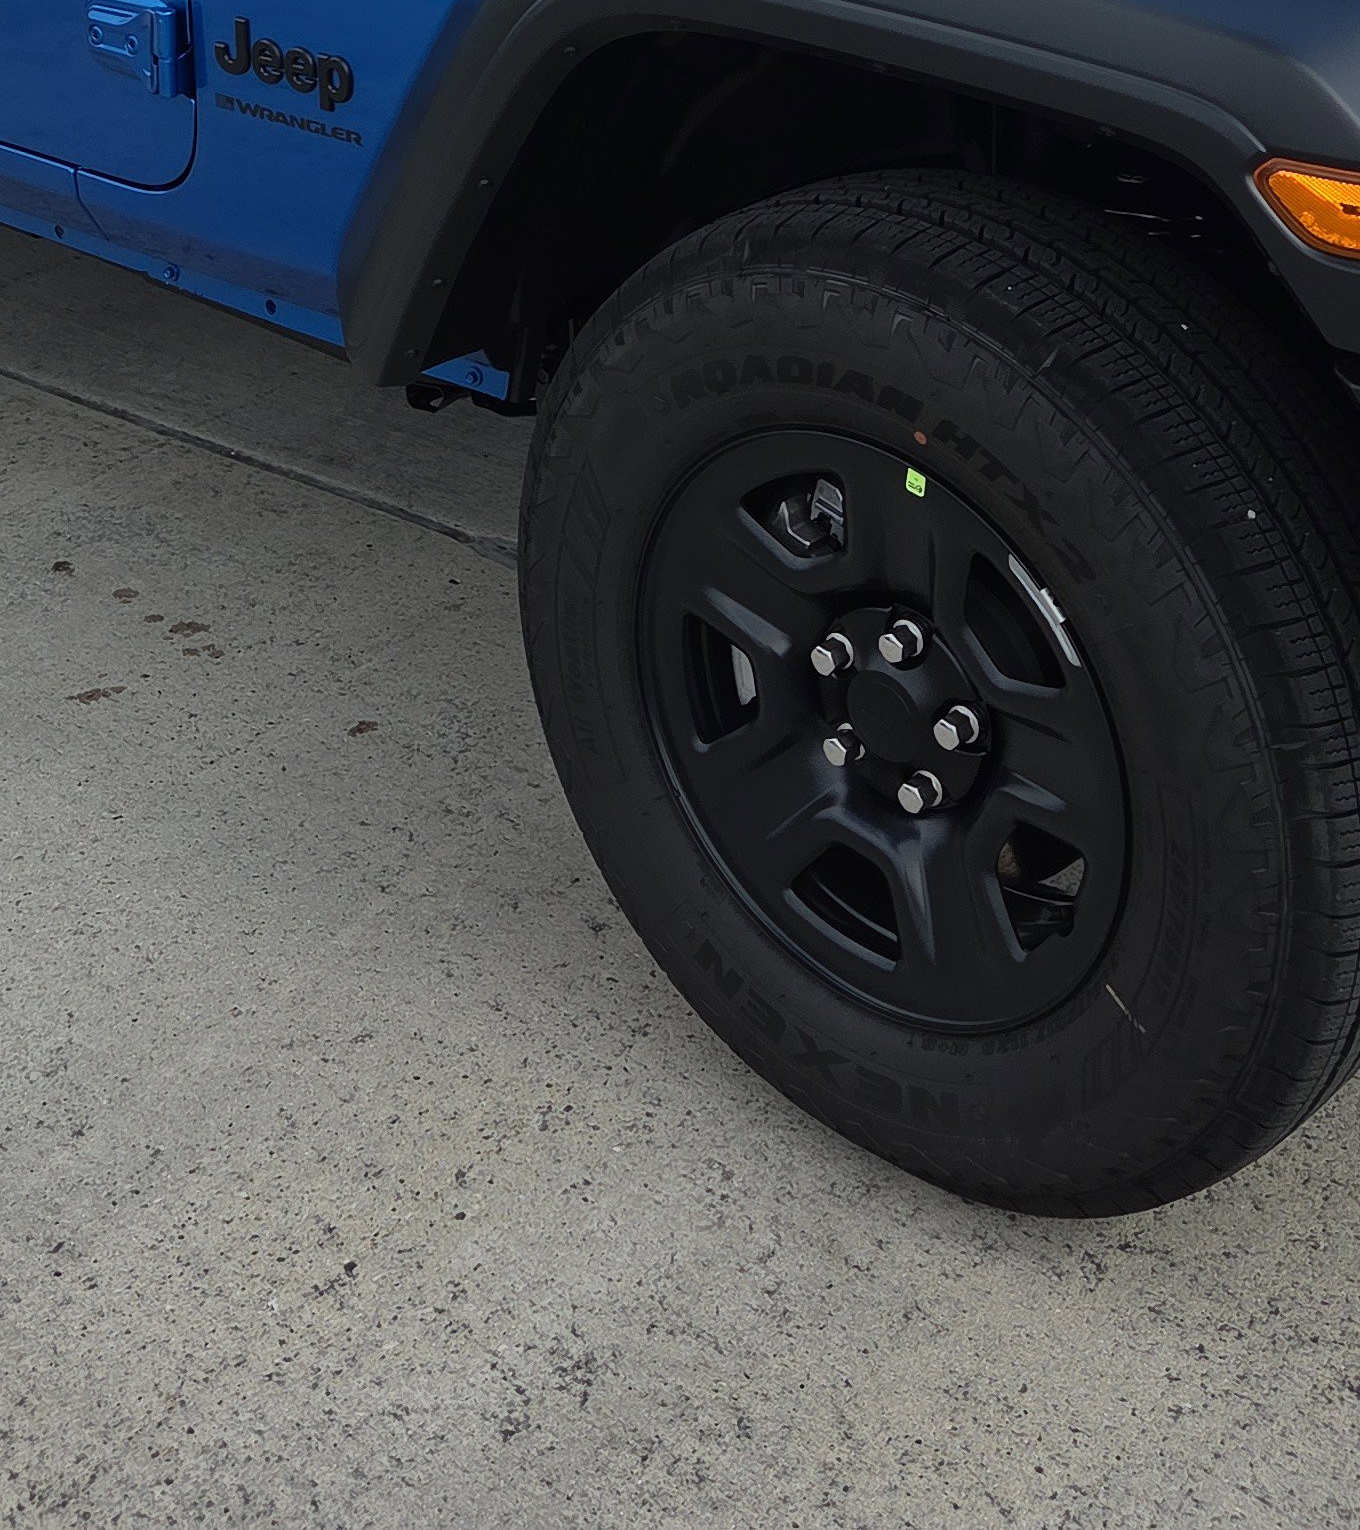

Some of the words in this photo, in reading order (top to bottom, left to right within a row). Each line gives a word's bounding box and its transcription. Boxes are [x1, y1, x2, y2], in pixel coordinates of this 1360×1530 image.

[214, 16, 355, 113] Jeep
[235, 98, 365, 147] WRANGLER
[669, 354, 924, 422] ROADIAN
[693, 938, 963, 1126] NEXEN
